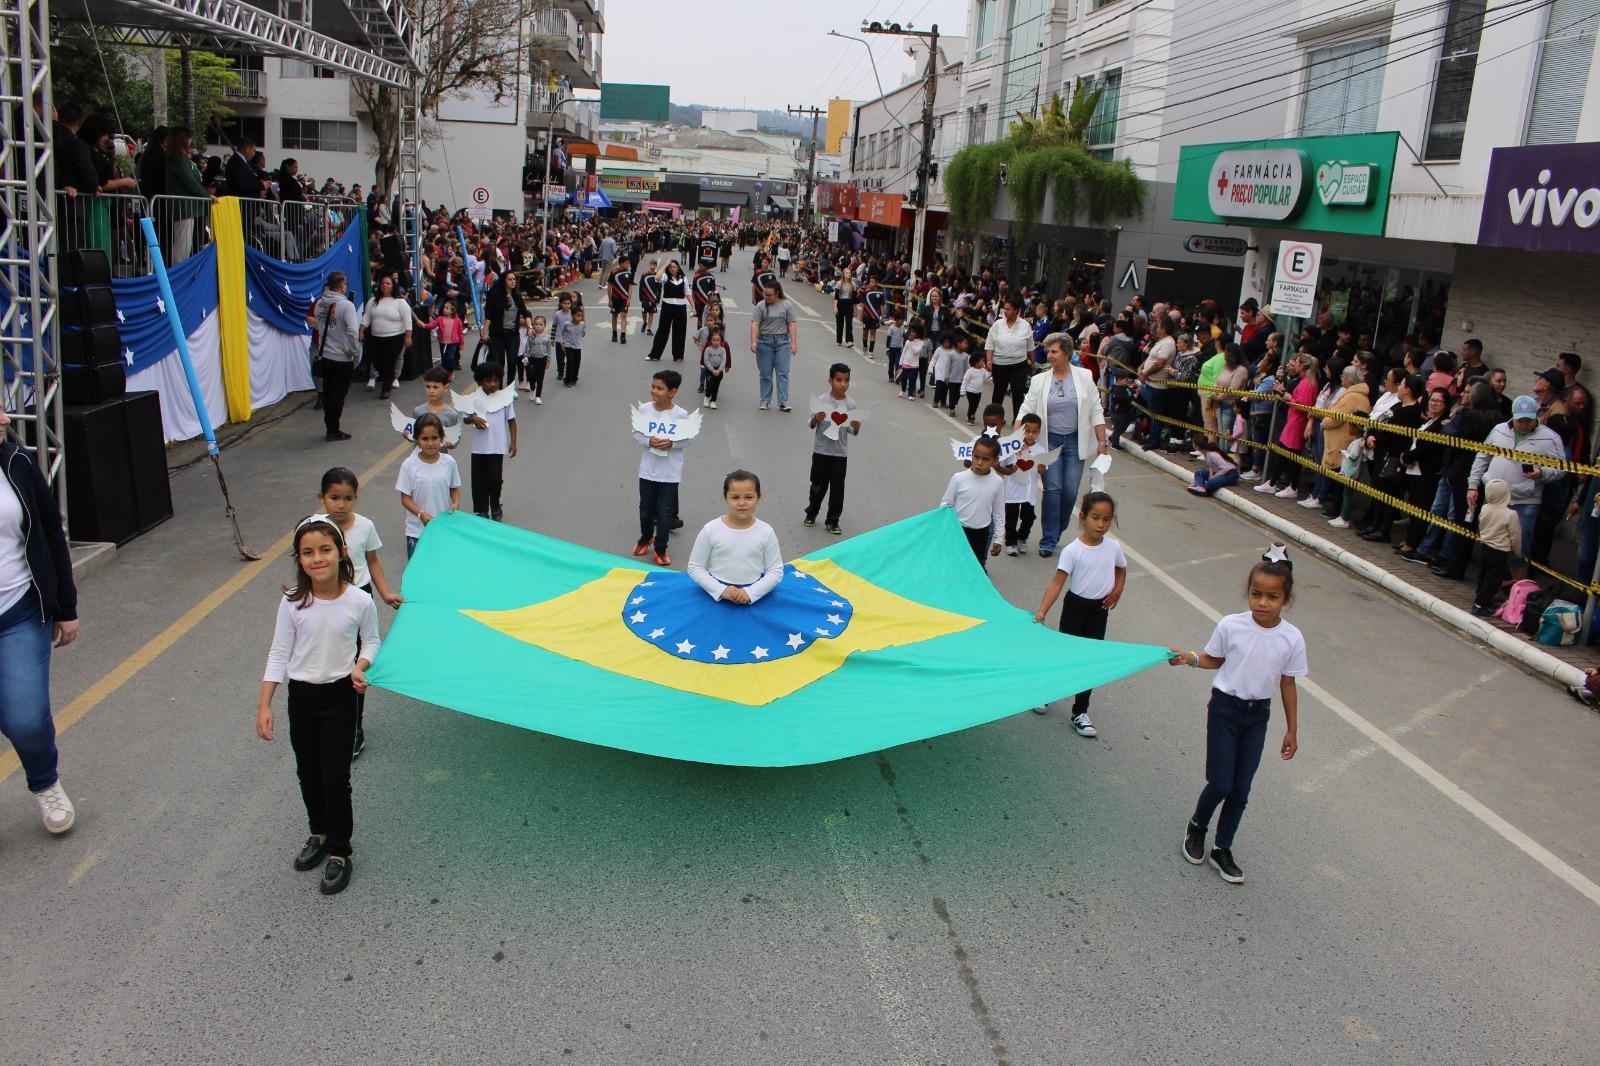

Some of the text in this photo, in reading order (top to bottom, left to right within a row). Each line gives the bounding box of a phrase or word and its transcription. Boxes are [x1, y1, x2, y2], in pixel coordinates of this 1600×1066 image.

[1233, 160, 1292, 179] FARMÁCIA
[477, 191, 484, 201] E
[1253, 184, 1291, 207] POPULAR
[1341, 184, 1366, 196] CUIDAR
[1508, 169, 1600, 229] vivo
[1292, 251, 1306, 273] E
[648, 422, 677, 435] PAZ
[958, 439, 1021, 458] RETO
